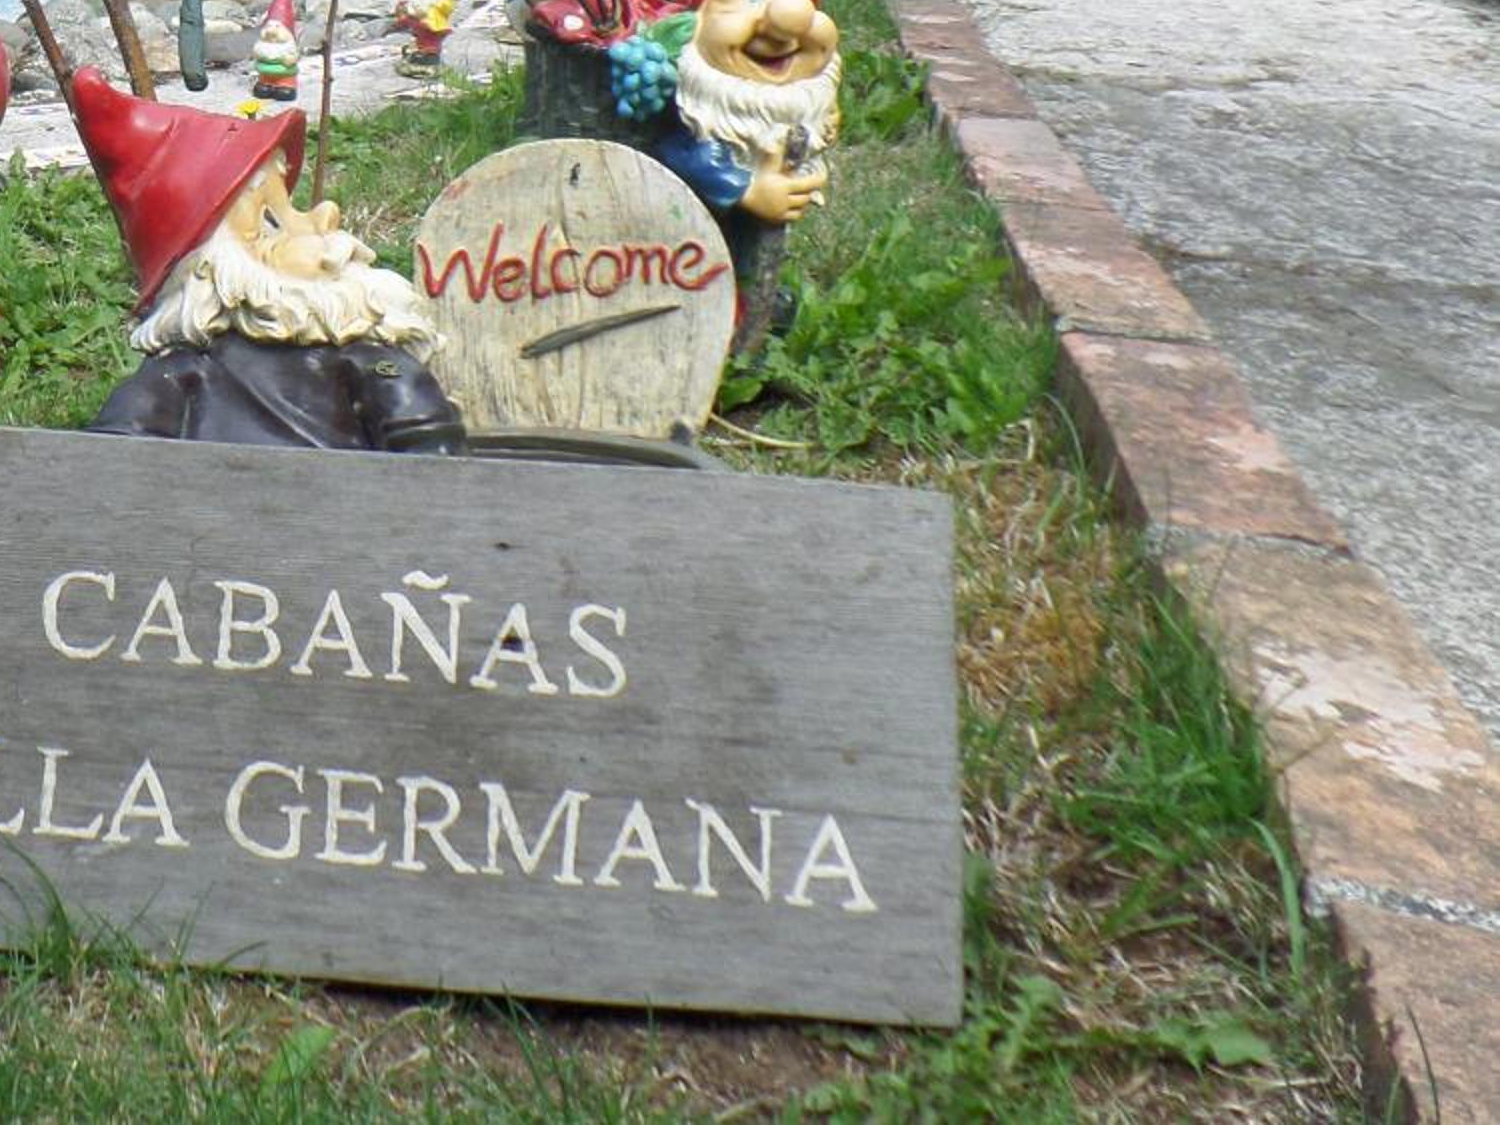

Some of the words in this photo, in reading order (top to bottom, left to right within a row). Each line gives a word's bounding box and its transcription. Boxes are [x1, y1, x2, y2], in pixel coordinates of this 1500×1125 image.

[417, 220, 729, 303] Welcome
[43, 571, 628, 697] CABAÑAS
[225, 760, 878, 913] GERMANA
